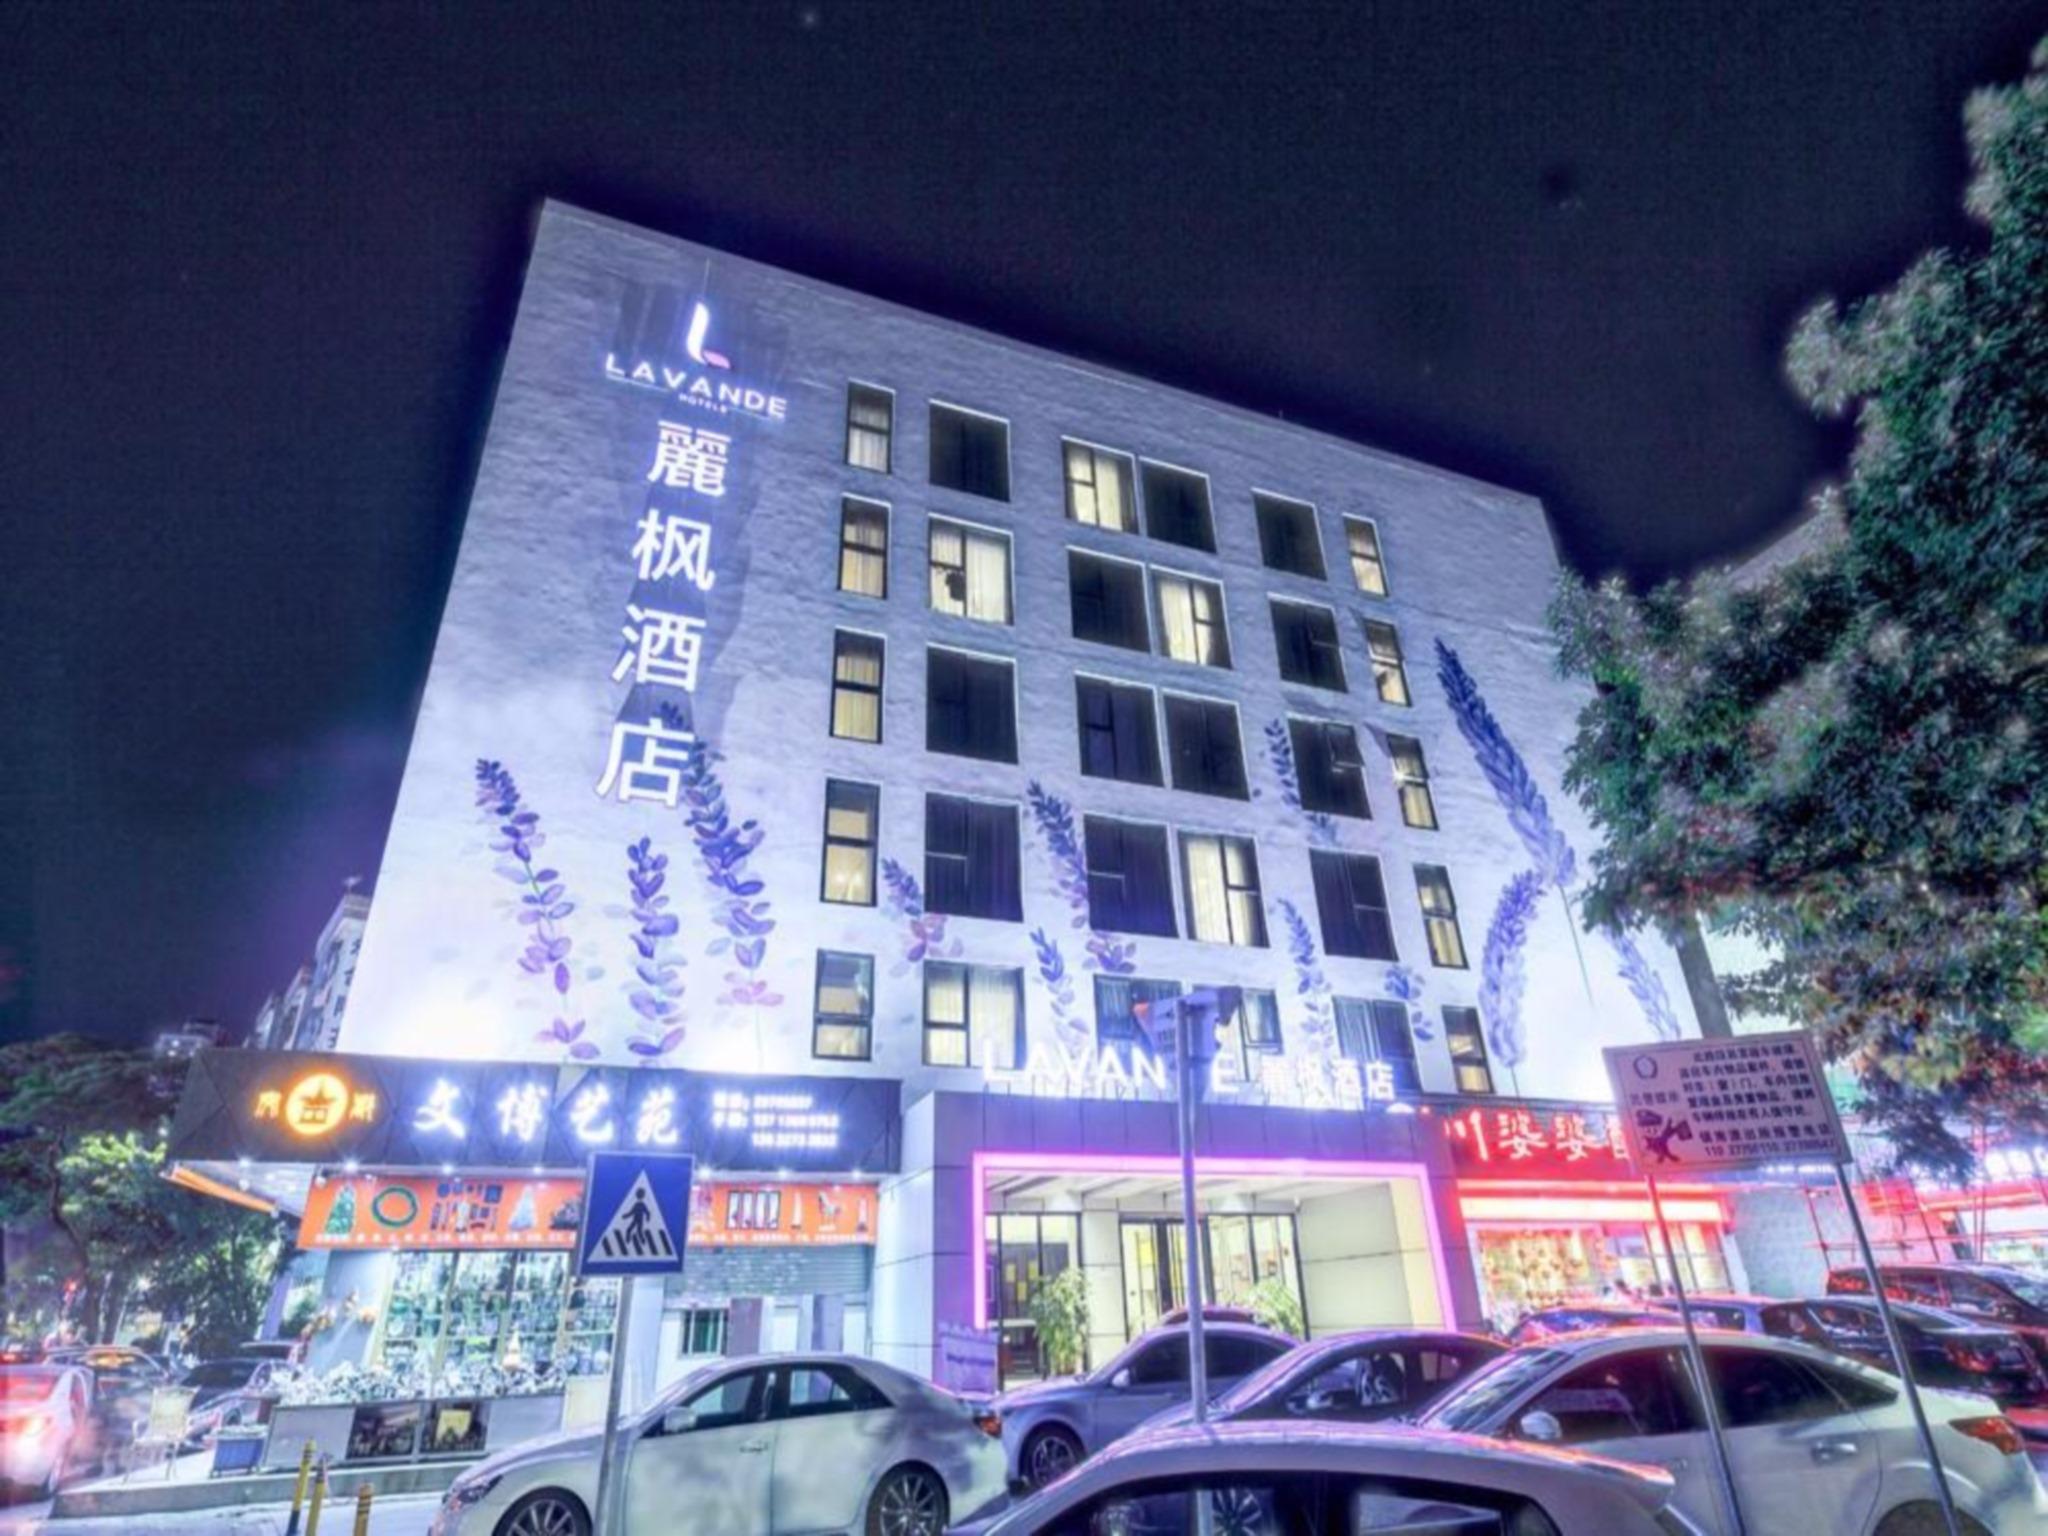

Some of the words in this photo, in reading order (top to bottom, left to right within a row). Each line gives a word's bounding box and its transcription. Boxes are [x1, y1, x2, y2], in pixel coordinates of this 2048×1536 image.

[604, 353, 788, 419] LAVANDE
[595, 420, 732, 809] 麗枫酒店
[981, 1037, 1241, 1094] LAVANE
[1703, 1144, 1725, 1157] 110
